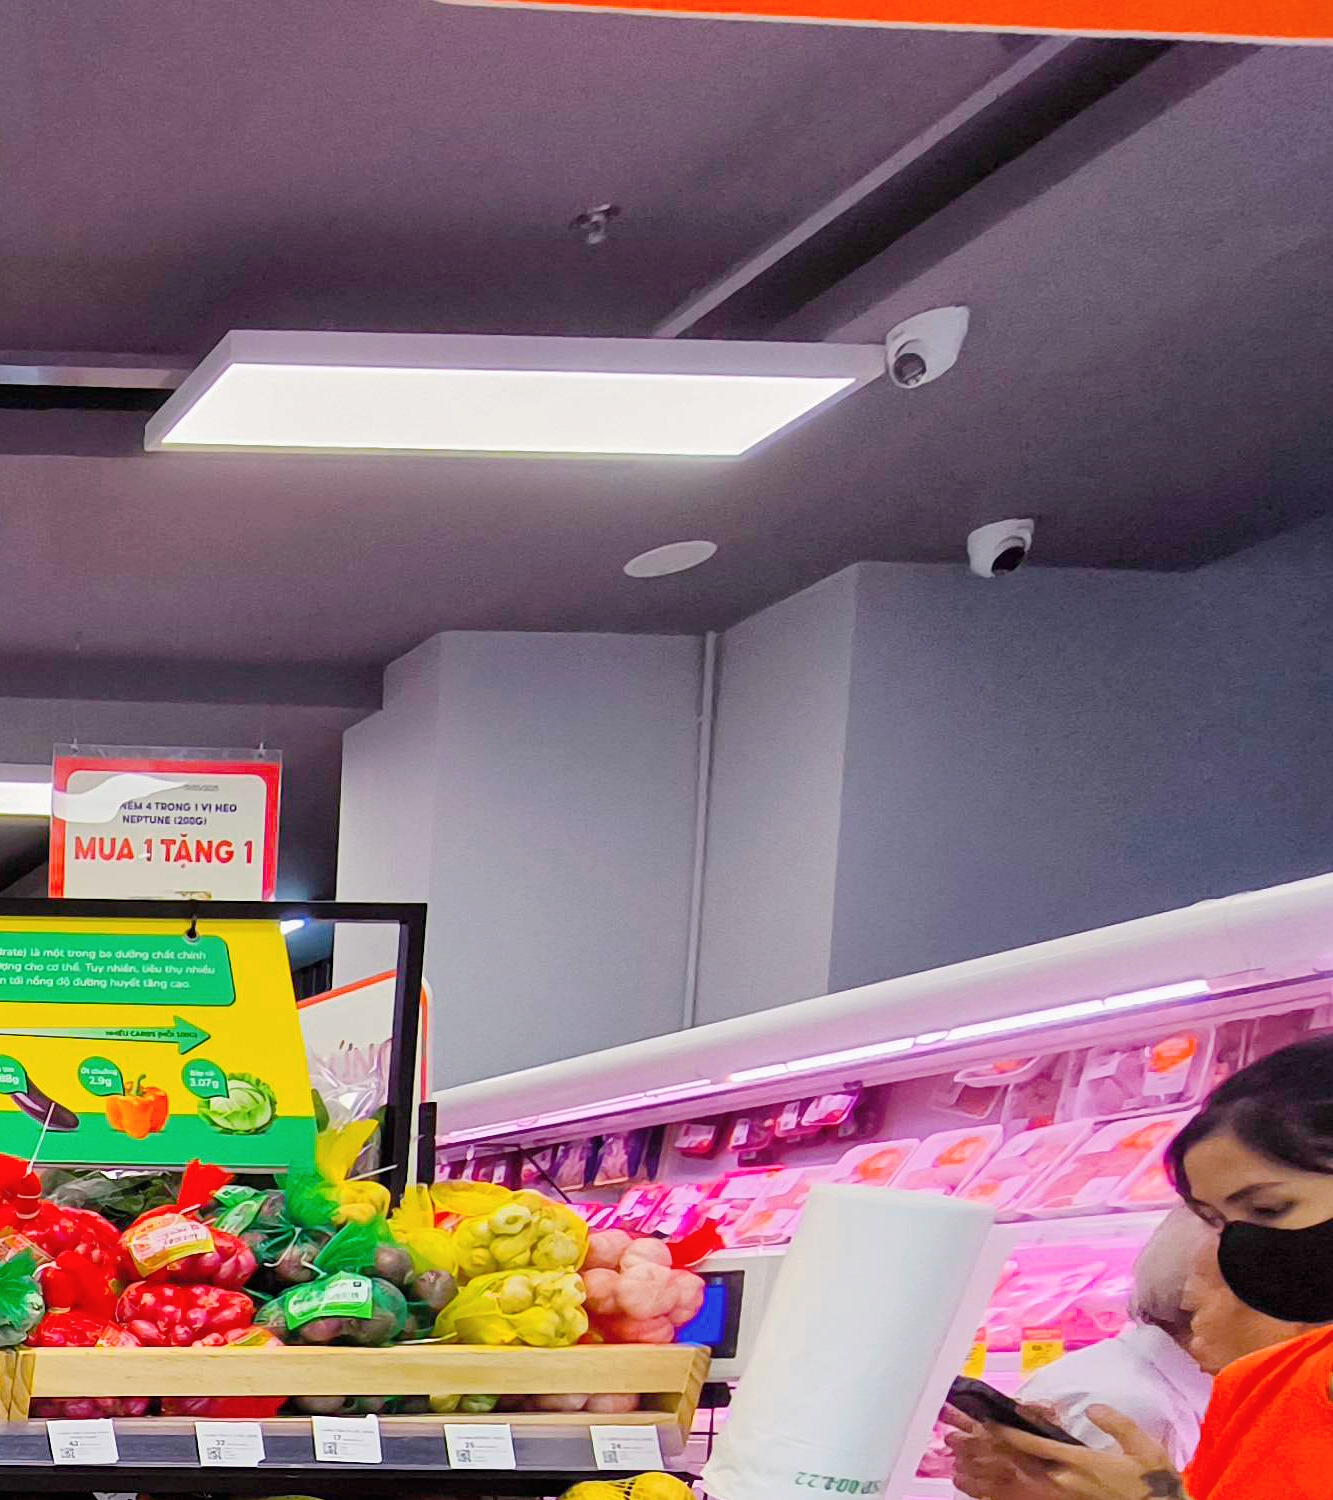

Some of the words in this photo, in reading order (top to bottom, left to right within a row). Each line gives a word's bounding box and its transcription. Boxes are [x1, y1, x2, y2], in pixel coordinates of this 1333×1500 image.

[155, 803, 191, 812] TRONG
[215, 804, 237, 812] HEO
[123, 815, 170, 825] NEPTUNE
[74, 836, 134, 861] MUA
[144, 838, 153, 862] 1
[161, 833, 234, 868] TẶNG
[244, 840, 253, 864] 1
[89, 1075, 112, 1088] 2.9g
